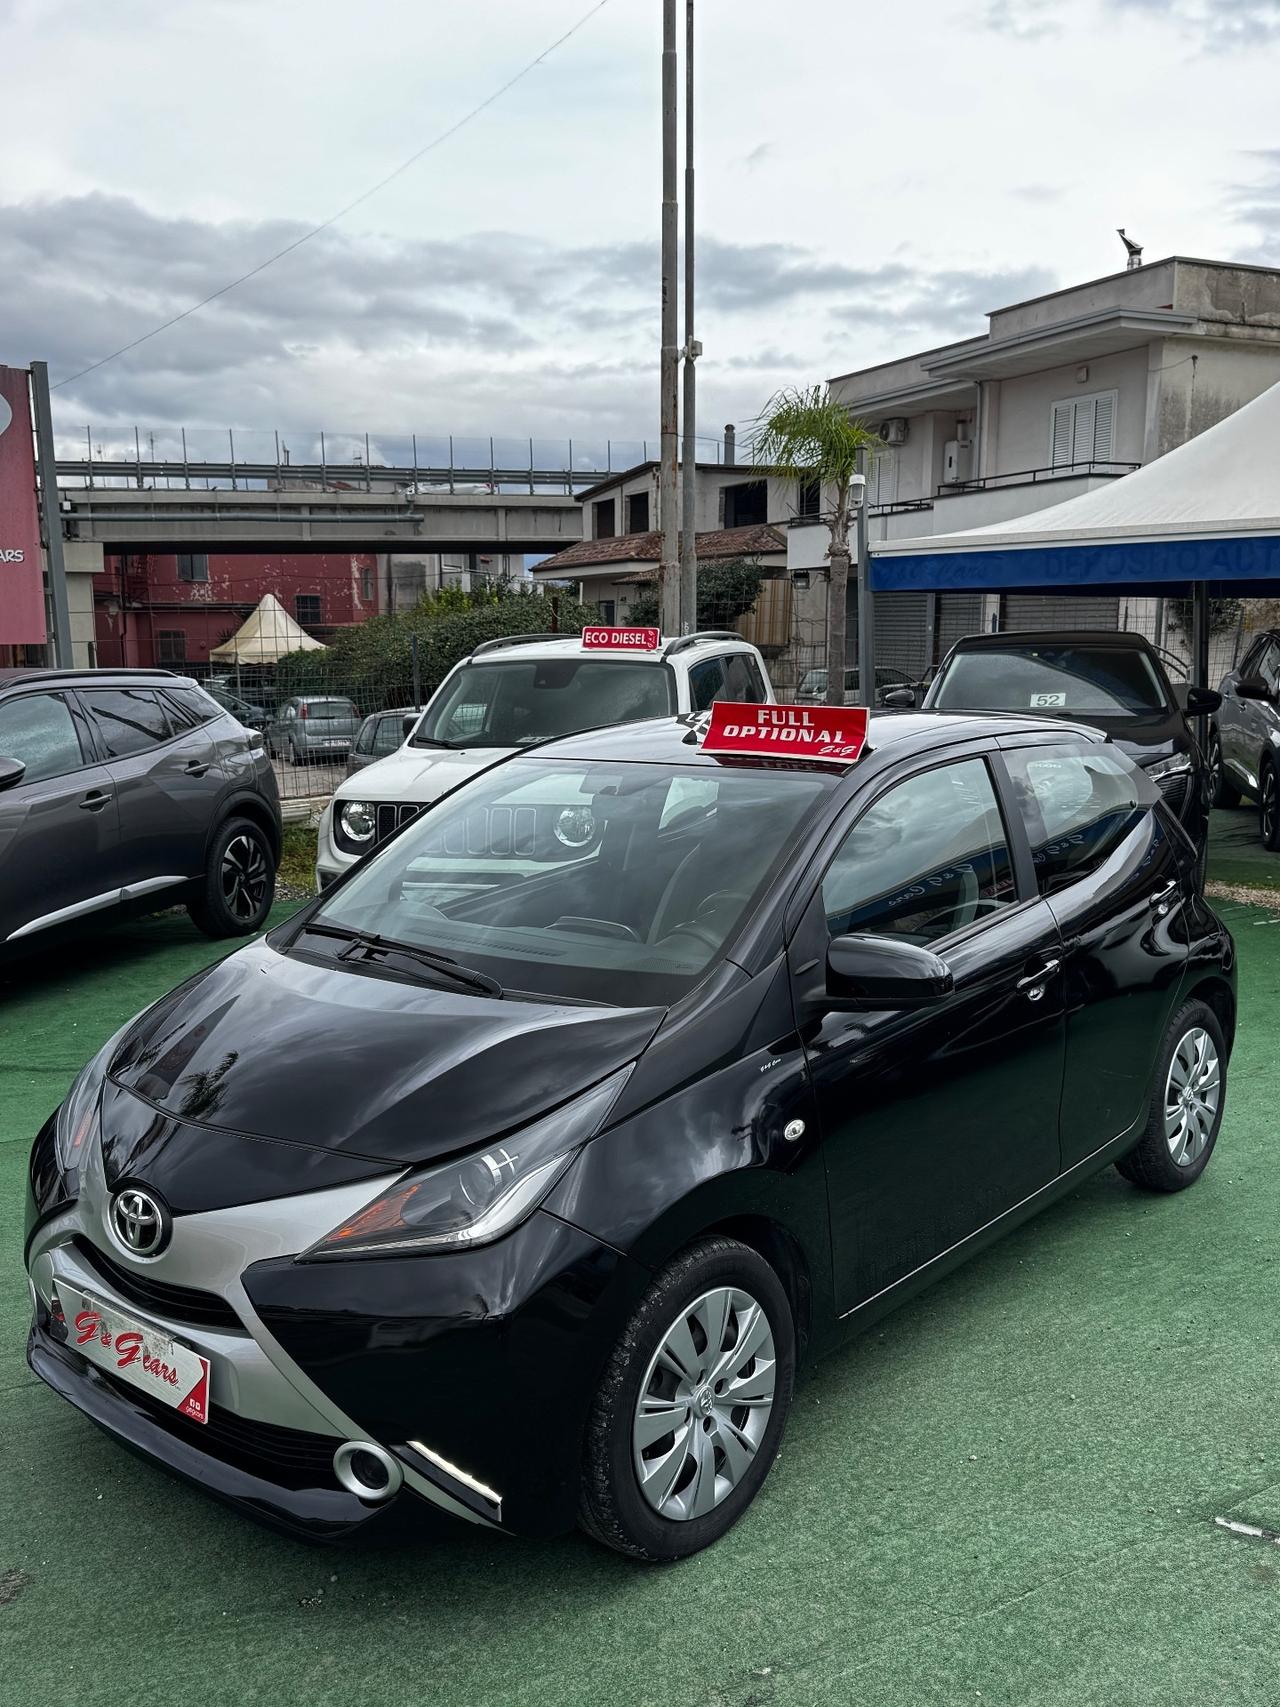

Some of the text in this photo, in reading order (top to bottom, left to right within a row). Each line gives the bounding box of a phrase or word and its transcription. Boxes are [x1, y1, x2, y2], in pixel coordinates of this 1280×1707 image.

[585, 632, 608, 643] ECO
[611, 632, 647, 645] DIESEL
[1036, 694, 1060, 706] 52
[757, 710, 815, 727] FULL
[722, 725, 846, 744] OPTIONAL
